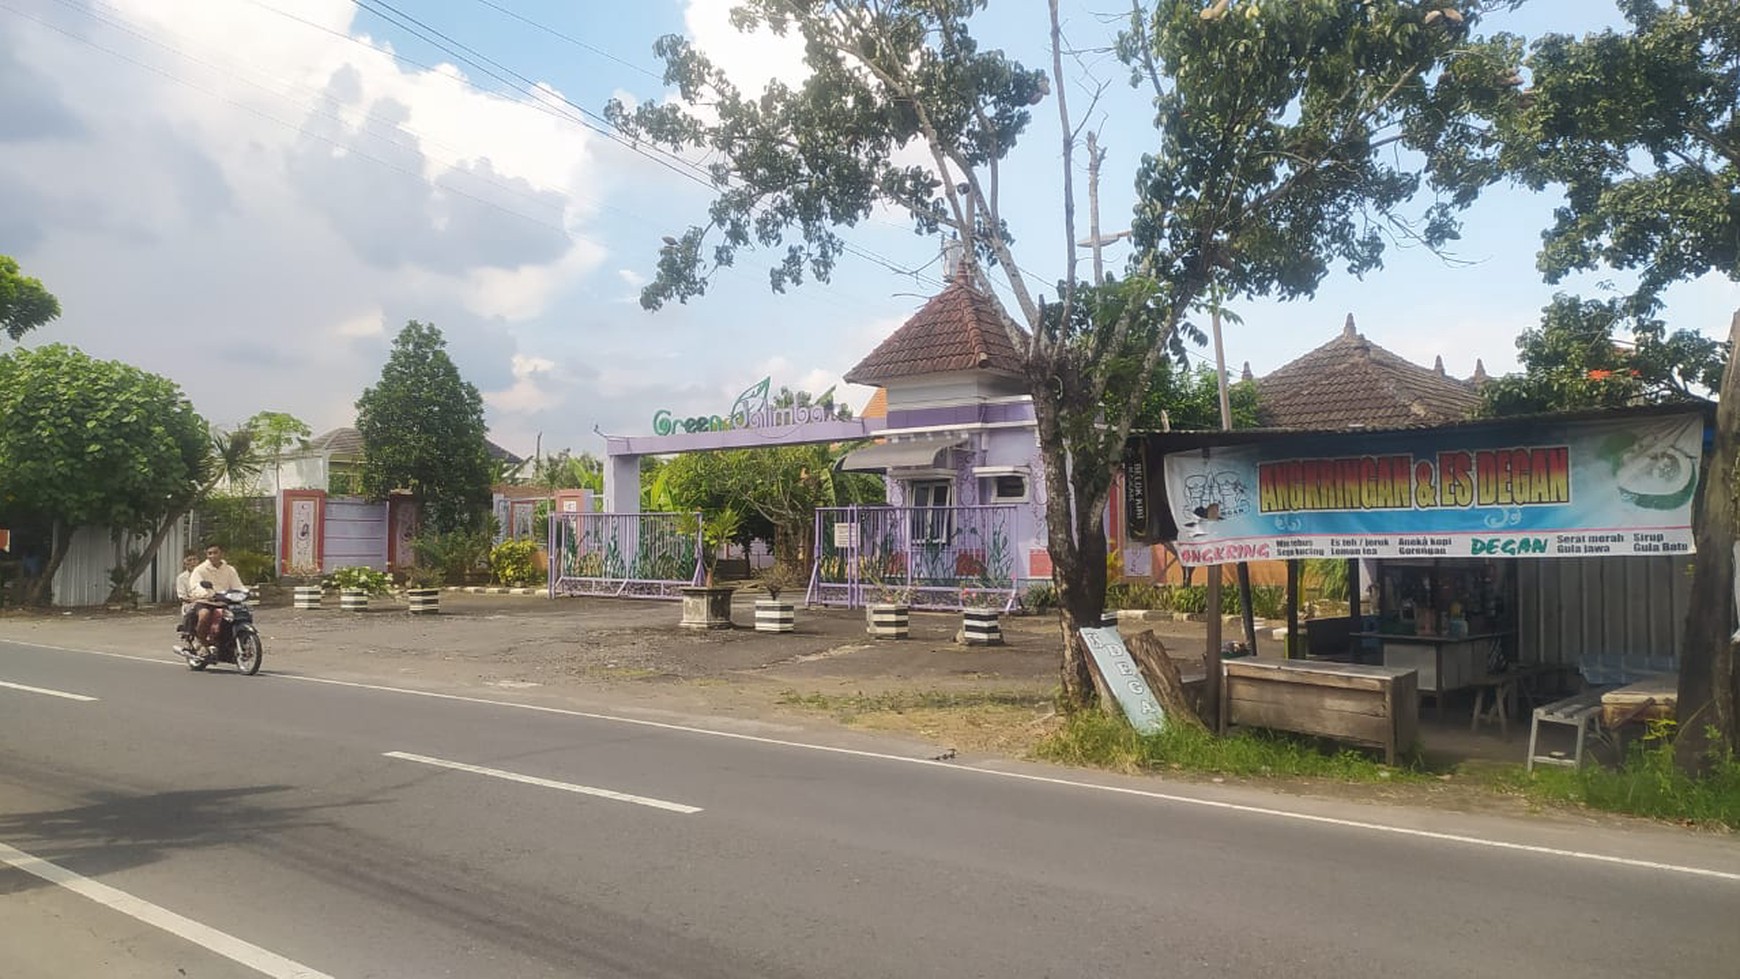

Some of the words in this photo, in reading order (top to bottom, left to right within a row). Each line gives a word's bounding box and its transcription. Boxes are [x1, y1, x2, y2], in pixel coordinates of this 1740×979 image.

[652, 409, 720, 437] Green
[1259, 455, 1413, 512] ANGKRINGAN
[1415, 460, 1437, 509] &
[1437, 450, 1474, 507] ES
[1476, 446, 1570, 505] DEGAN
[1181, 543, 1270, 563] ANGKRING
[1471, 537, 1548, 555] DEGAN
[1633, 542, 1660, 552] Gula
[1662, 542, 1688, 551] Batu
